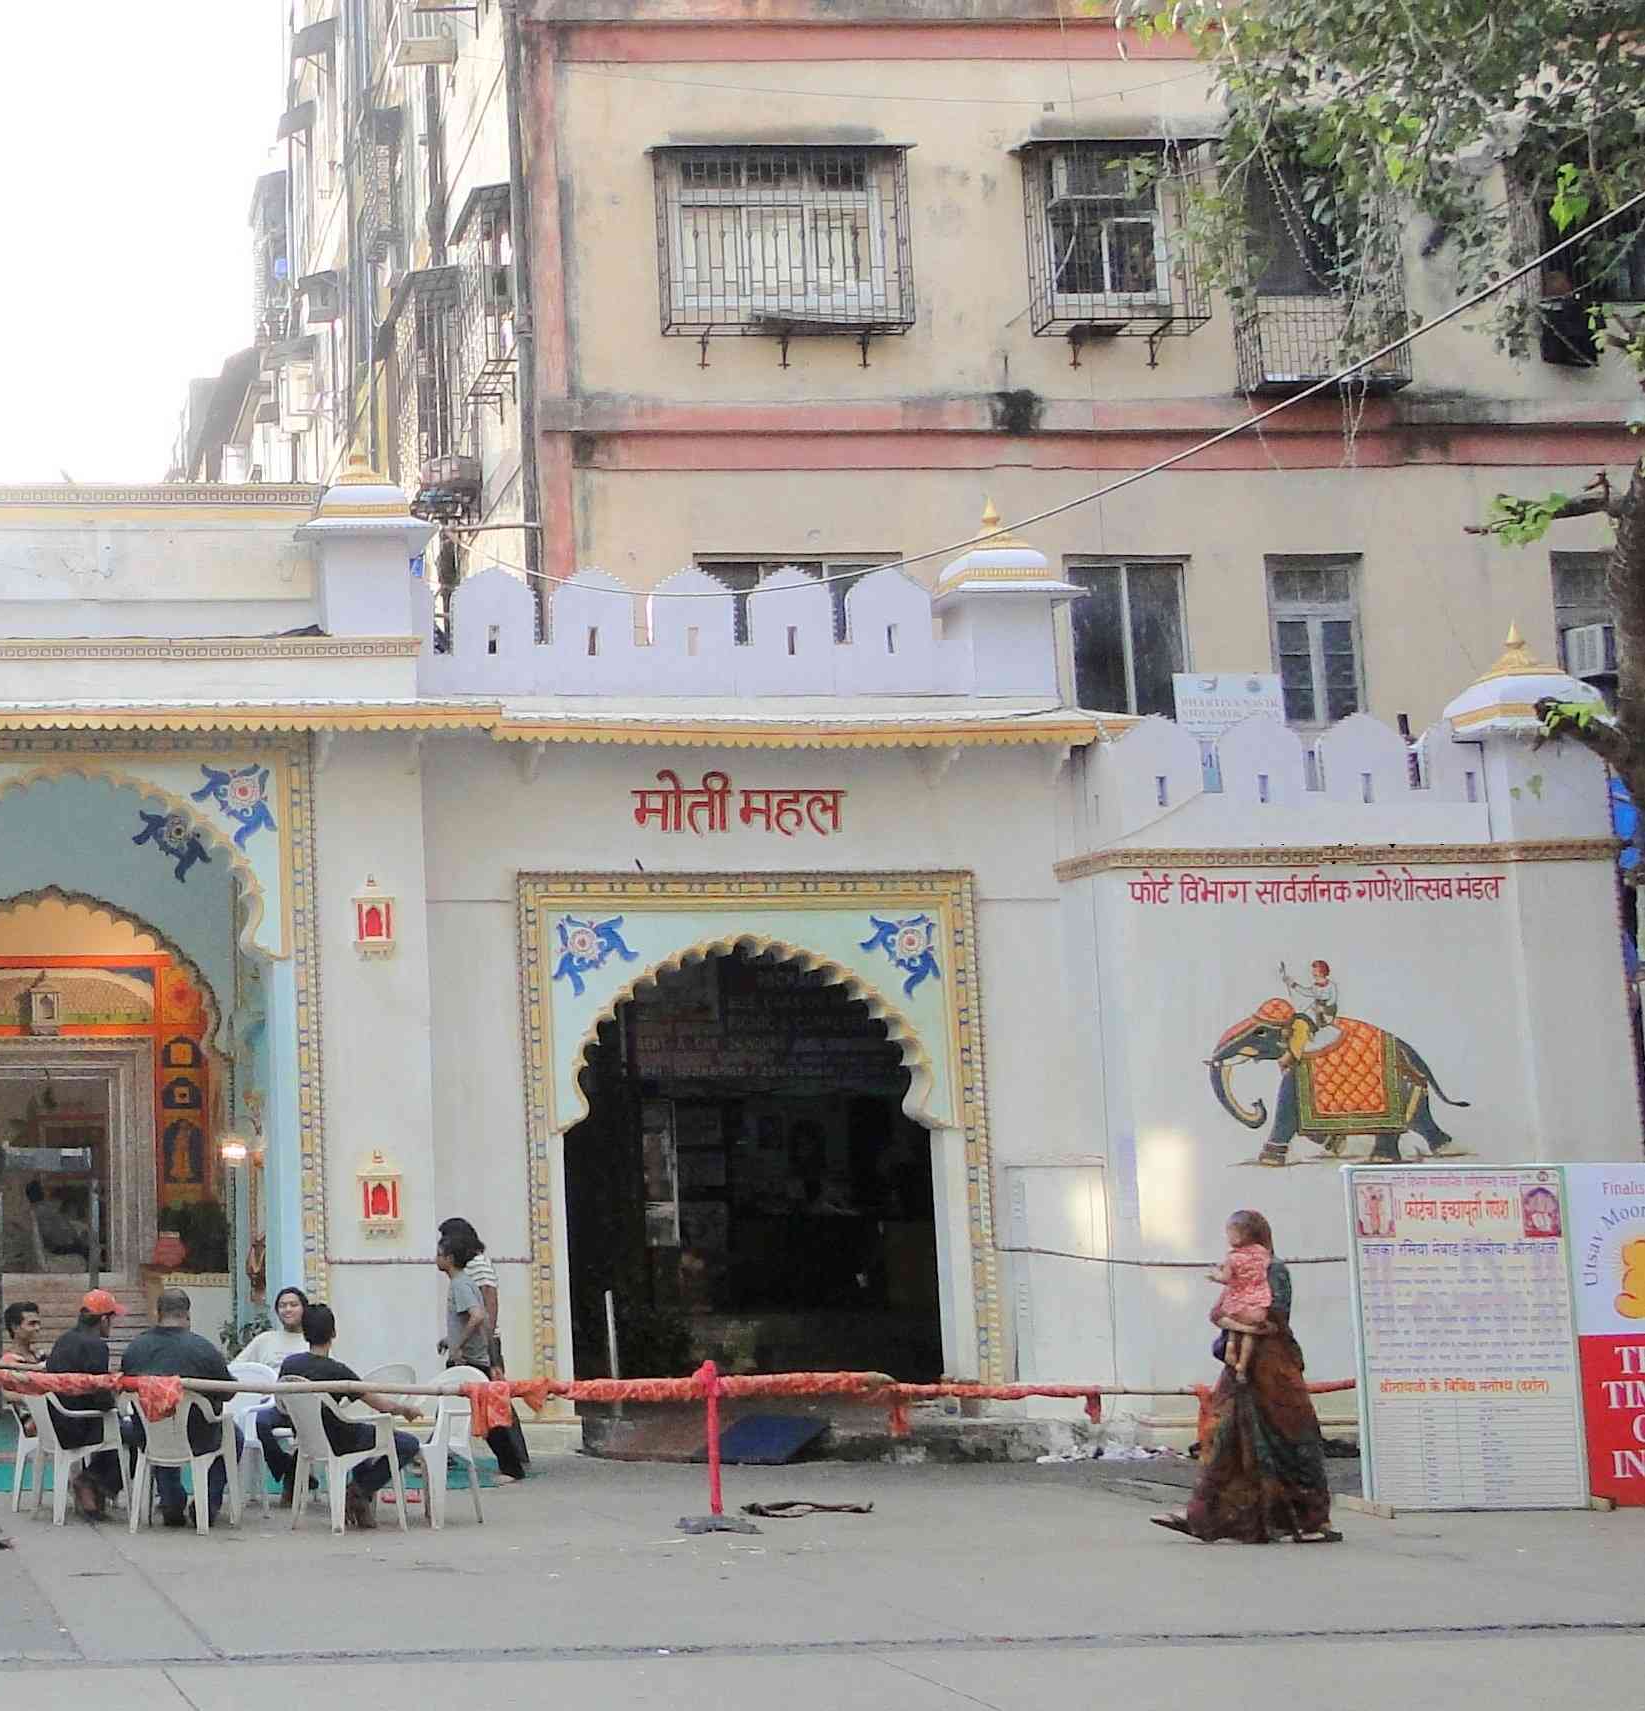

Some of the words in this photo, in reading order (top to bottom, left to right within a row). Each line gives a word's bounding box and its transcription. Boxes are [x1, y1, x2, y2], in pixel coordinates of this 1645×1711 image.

[630, 769, 733, 837] मोती
[740, 789, 848, 836] महल
[1127, 870, 1174, 904] फोर्ट
[1178, 872, 1252, 904] विभाग
[1352, 866, 1452, 902] गणेशोत्सव
[1454, 872, 1506, 900] मंडल
